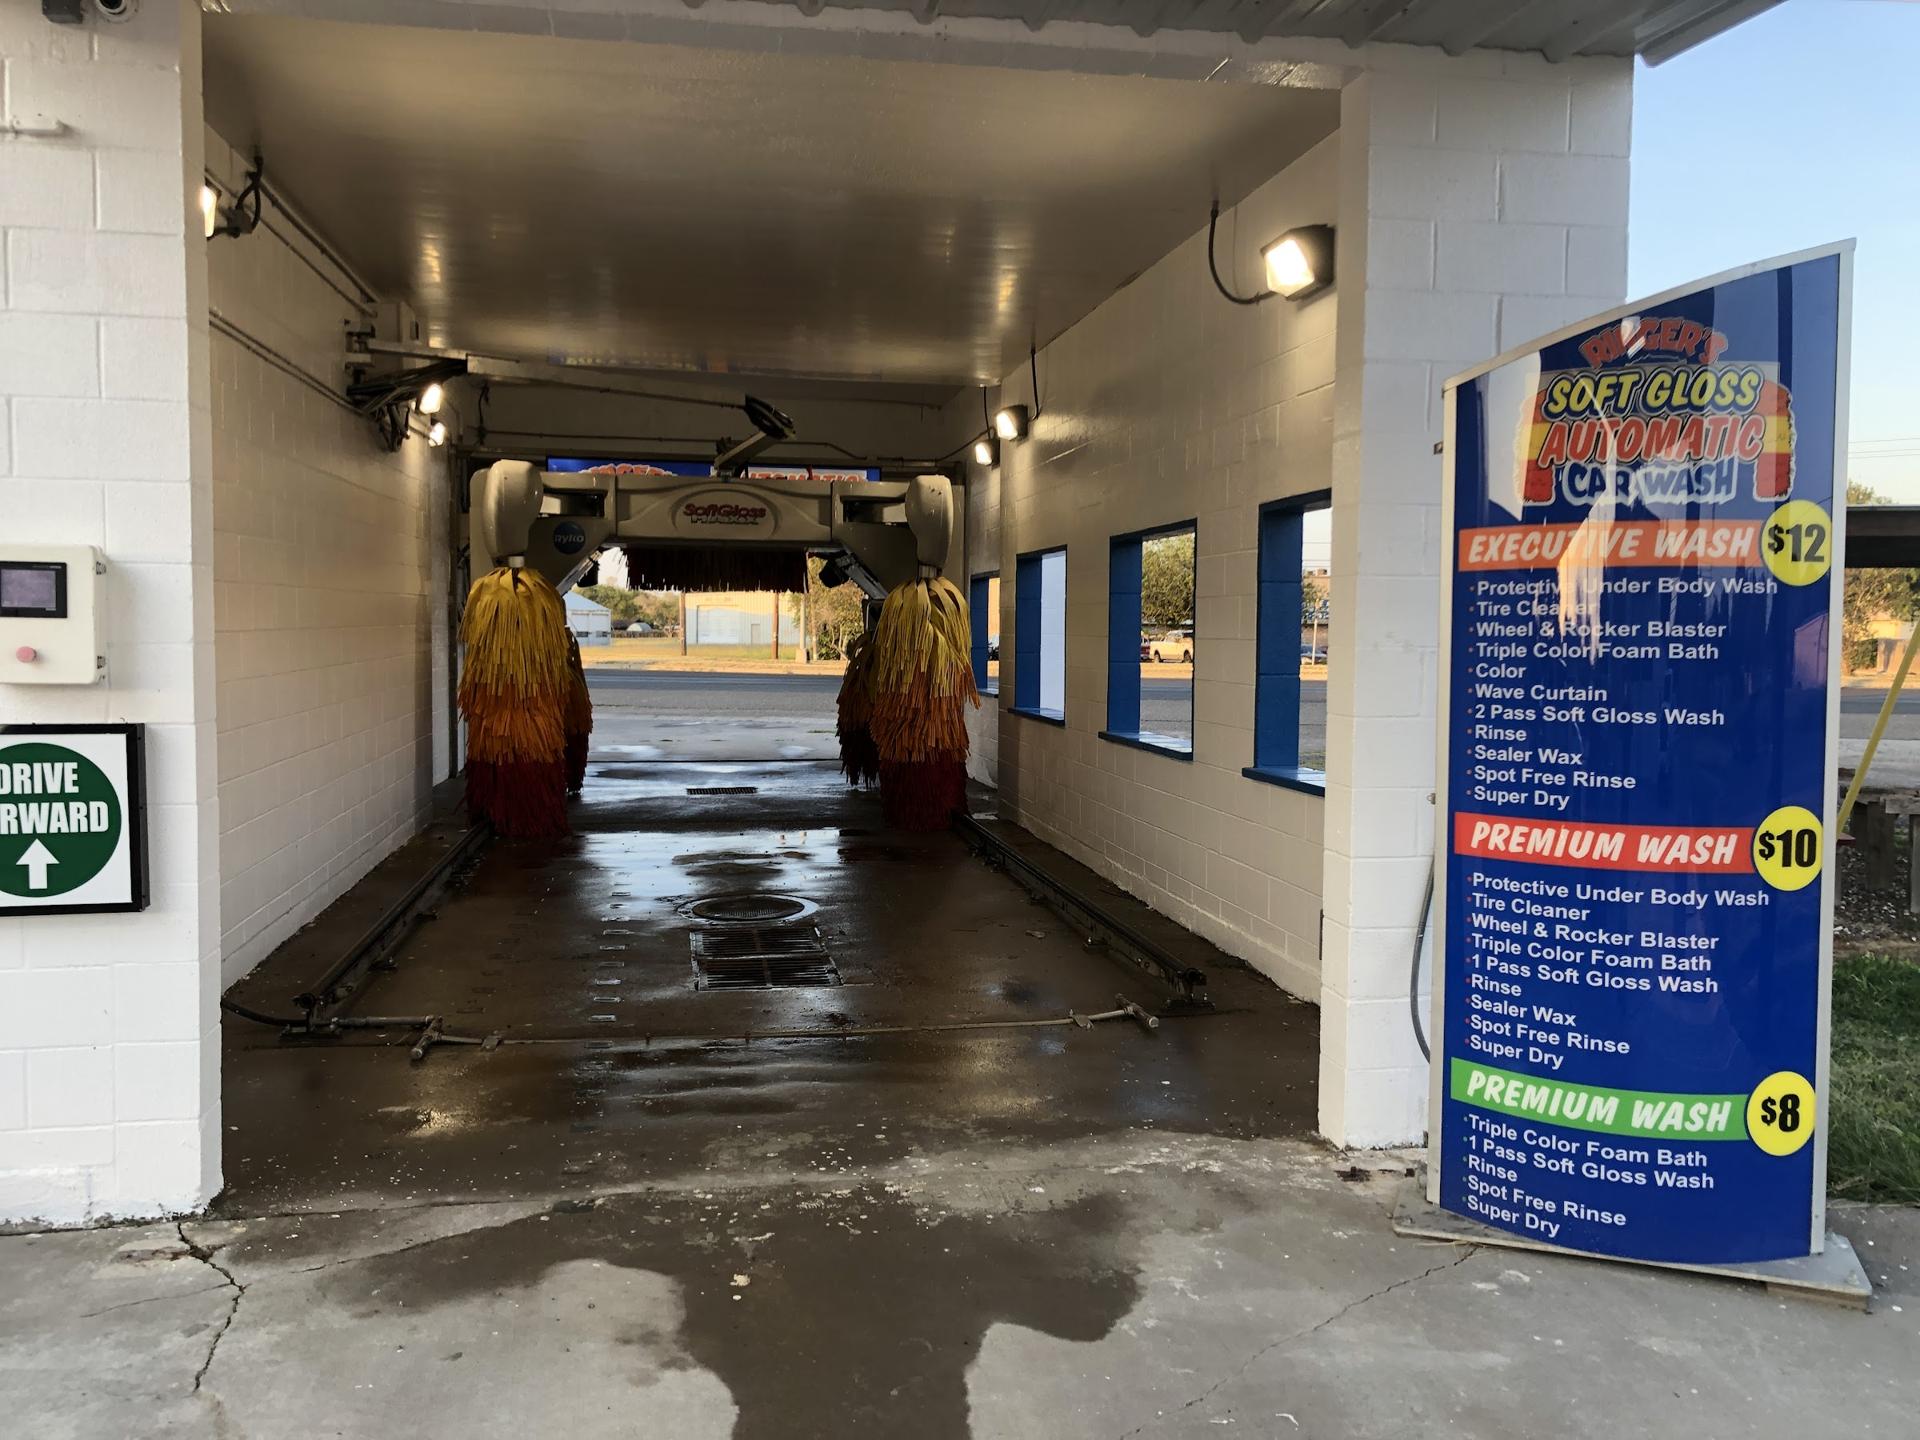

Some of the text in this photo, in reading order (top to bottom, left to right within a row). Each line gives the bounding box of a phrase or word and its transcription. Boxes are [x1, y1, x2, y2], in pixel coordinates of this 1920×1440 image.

[1545, 367, 1762, 417] SOFT GLOSS
[1538, 415, 1765, 468] AUTOMATIC
[1564, 459, 1736, 502] CAR WASH
[1468, 527, 1755, 563] EXECUTIVE WASH
[1767, 524, 1826, 563] $12
[1583, 578, 1650, 595] Under
[1658, 577, 1715, 597] Body
[1722, 578, 1778, 594] Wash
[1476, 601, 1599, 617] Tire Cleaer
[1476, 621, 1727, 638] Wheel & Rocker Blaster
[1476, 643, 1719, 660] Triple Color Foam Bath
[1475, 663, 1526, 679] Color
[1475, 684, 1608, 701] Wave Curtain
[1475, 704, 1725, 726] 2 Pass Soft Gloss Wash
[1475, 725, 1527, 742] Rinse
[1474, 745, 1583, 766] Sealer Wax
[0, 762, 79, 795] DRIVE
[1474, 765, 1636, 789] Spot Free Rinse
[1474, 785, 1570, 810] Super Dry
[1470, 821, 1738, 866] PREMIUM WASH
[1758, 828, 1817, 868] $10
[1472, 872, 1769, 910] Protective Under Body Wash
[1472, 893, 1590, 922] Tire Cleaner
[1472, 913, 1718, 950] Wheel & Rocker Blaster
[1471, 933, 1711, 972] Triple Color Foam Bath
[1471, 954, 1718, 993] 1 Pass Soft Gloss Wash
[1471, 974, 1522, 997] Rinse
[1470, 994, 1577, 1027] Sealer Wax
[1470, 1015, 1630, 1054] Spot Free Rinse
[1470, 1035, 1564, 1070] Super Dry
[1466, 1070, 1732, 1132] PREMIUM WASH
[1761, 1093, 1801, 1133] $8
[1469, 1114, 1708, 1167] Triple Color Foam Bath
[1468, 1135, 1715, 1189] 1 Pass Soft Gloss Wash
[1468, 1155, 1518, 1182] Rinse
[1467, 1195, 1561, 1238] Super Dry
[1468, 1175, 1627, 1226] Spot Free Rinse
